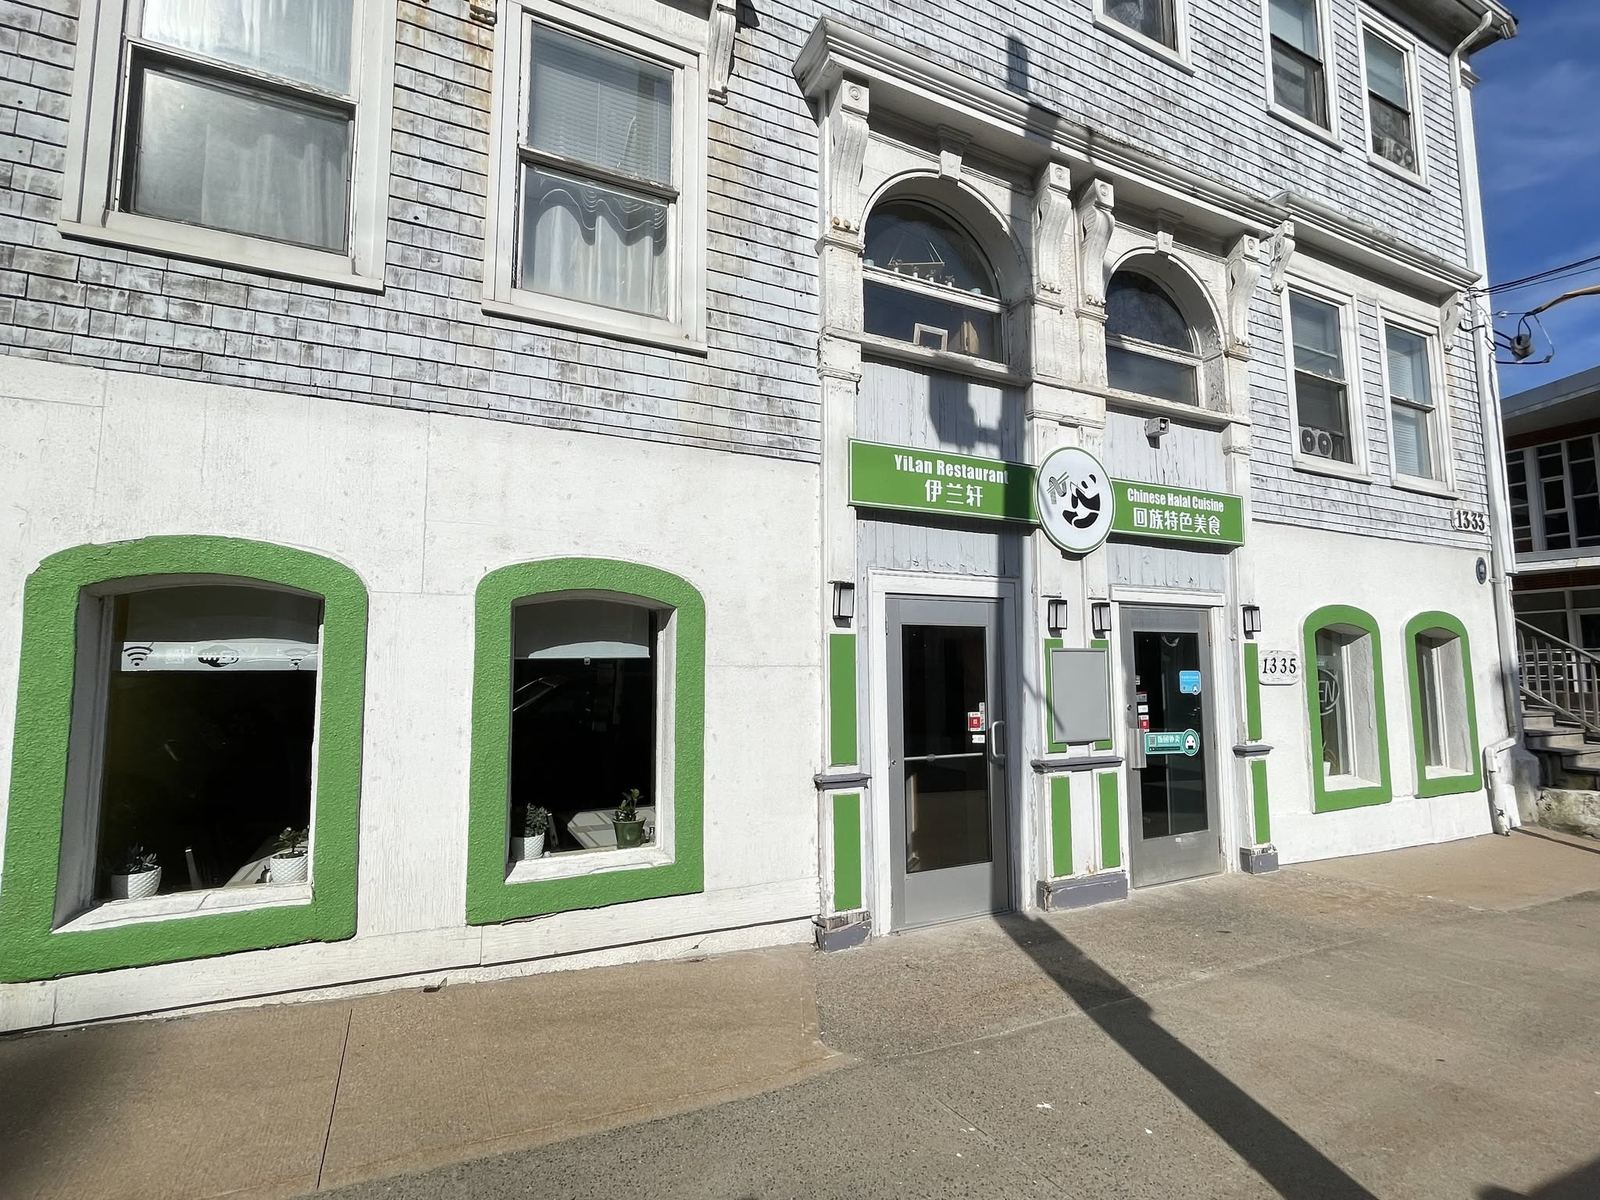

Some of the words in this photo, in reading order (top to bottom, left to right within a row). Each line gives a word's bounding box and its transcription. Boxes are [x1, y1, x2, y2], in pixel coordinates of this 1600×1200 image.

[894, 454, 932, 474] YiLan
[937, 460, 1009, 484] Restaurant
[925, 479, 983, 507] 伊兰轩
[1128, 487, 1166, 505] Chinese
[1167, 493, 1191, 508] Halal
[1192, 495, 1223, 513] Cuisine
[1133, 507, 1220, 536] 回族特色美食
[1457, 511, 1485, 530] 1333
[1262, 657, 1297, 674] 1335
